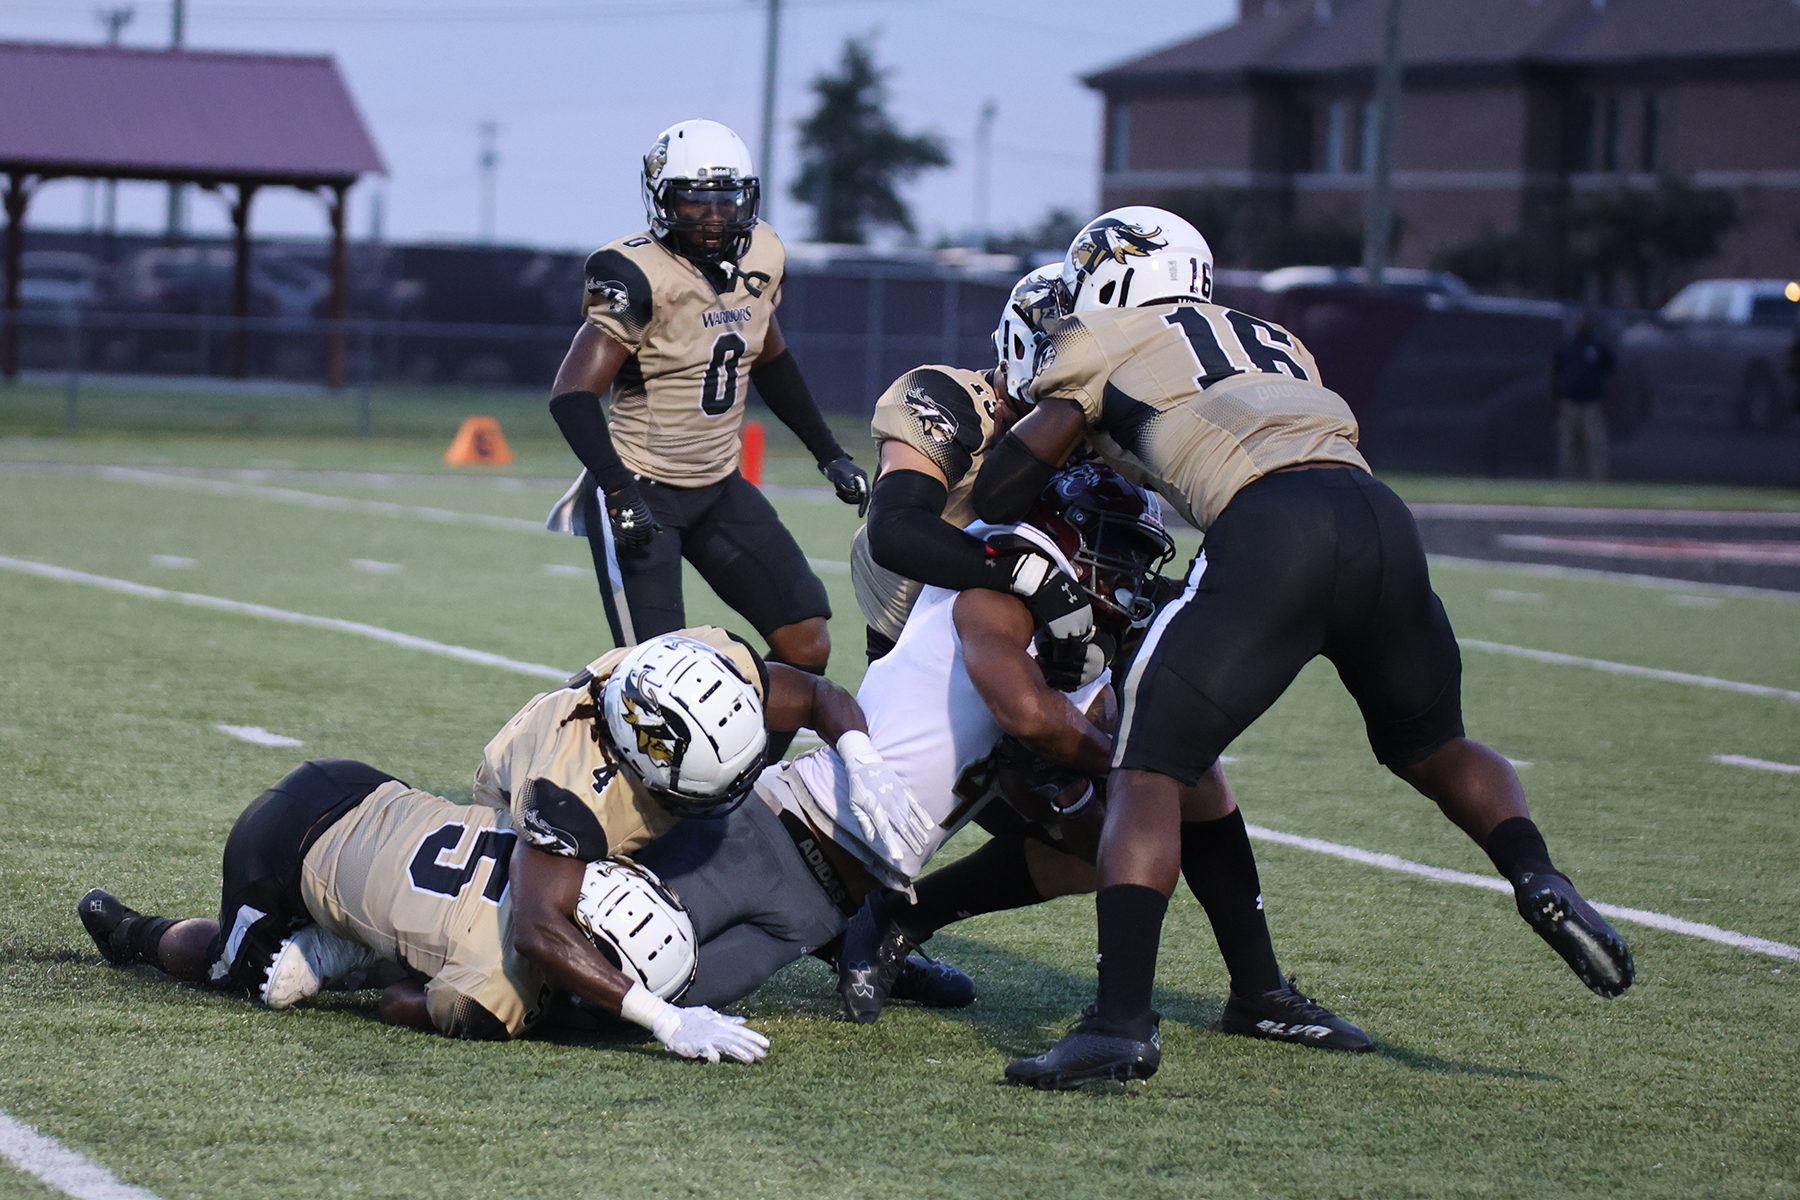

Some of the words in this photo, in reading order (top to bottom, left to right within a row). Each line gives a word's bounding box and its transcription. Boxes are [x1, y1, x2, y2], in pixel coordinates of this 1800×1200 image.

[1189, 257, 1211, 299] 16
[701, 305, 752, 328] WARRIORS
[700, 330, 747, 417] 0
[590, 760, 619, 795] 4
[405, 820, 518, 907] 5
[799, 838, 846, 903] ADIDAS
